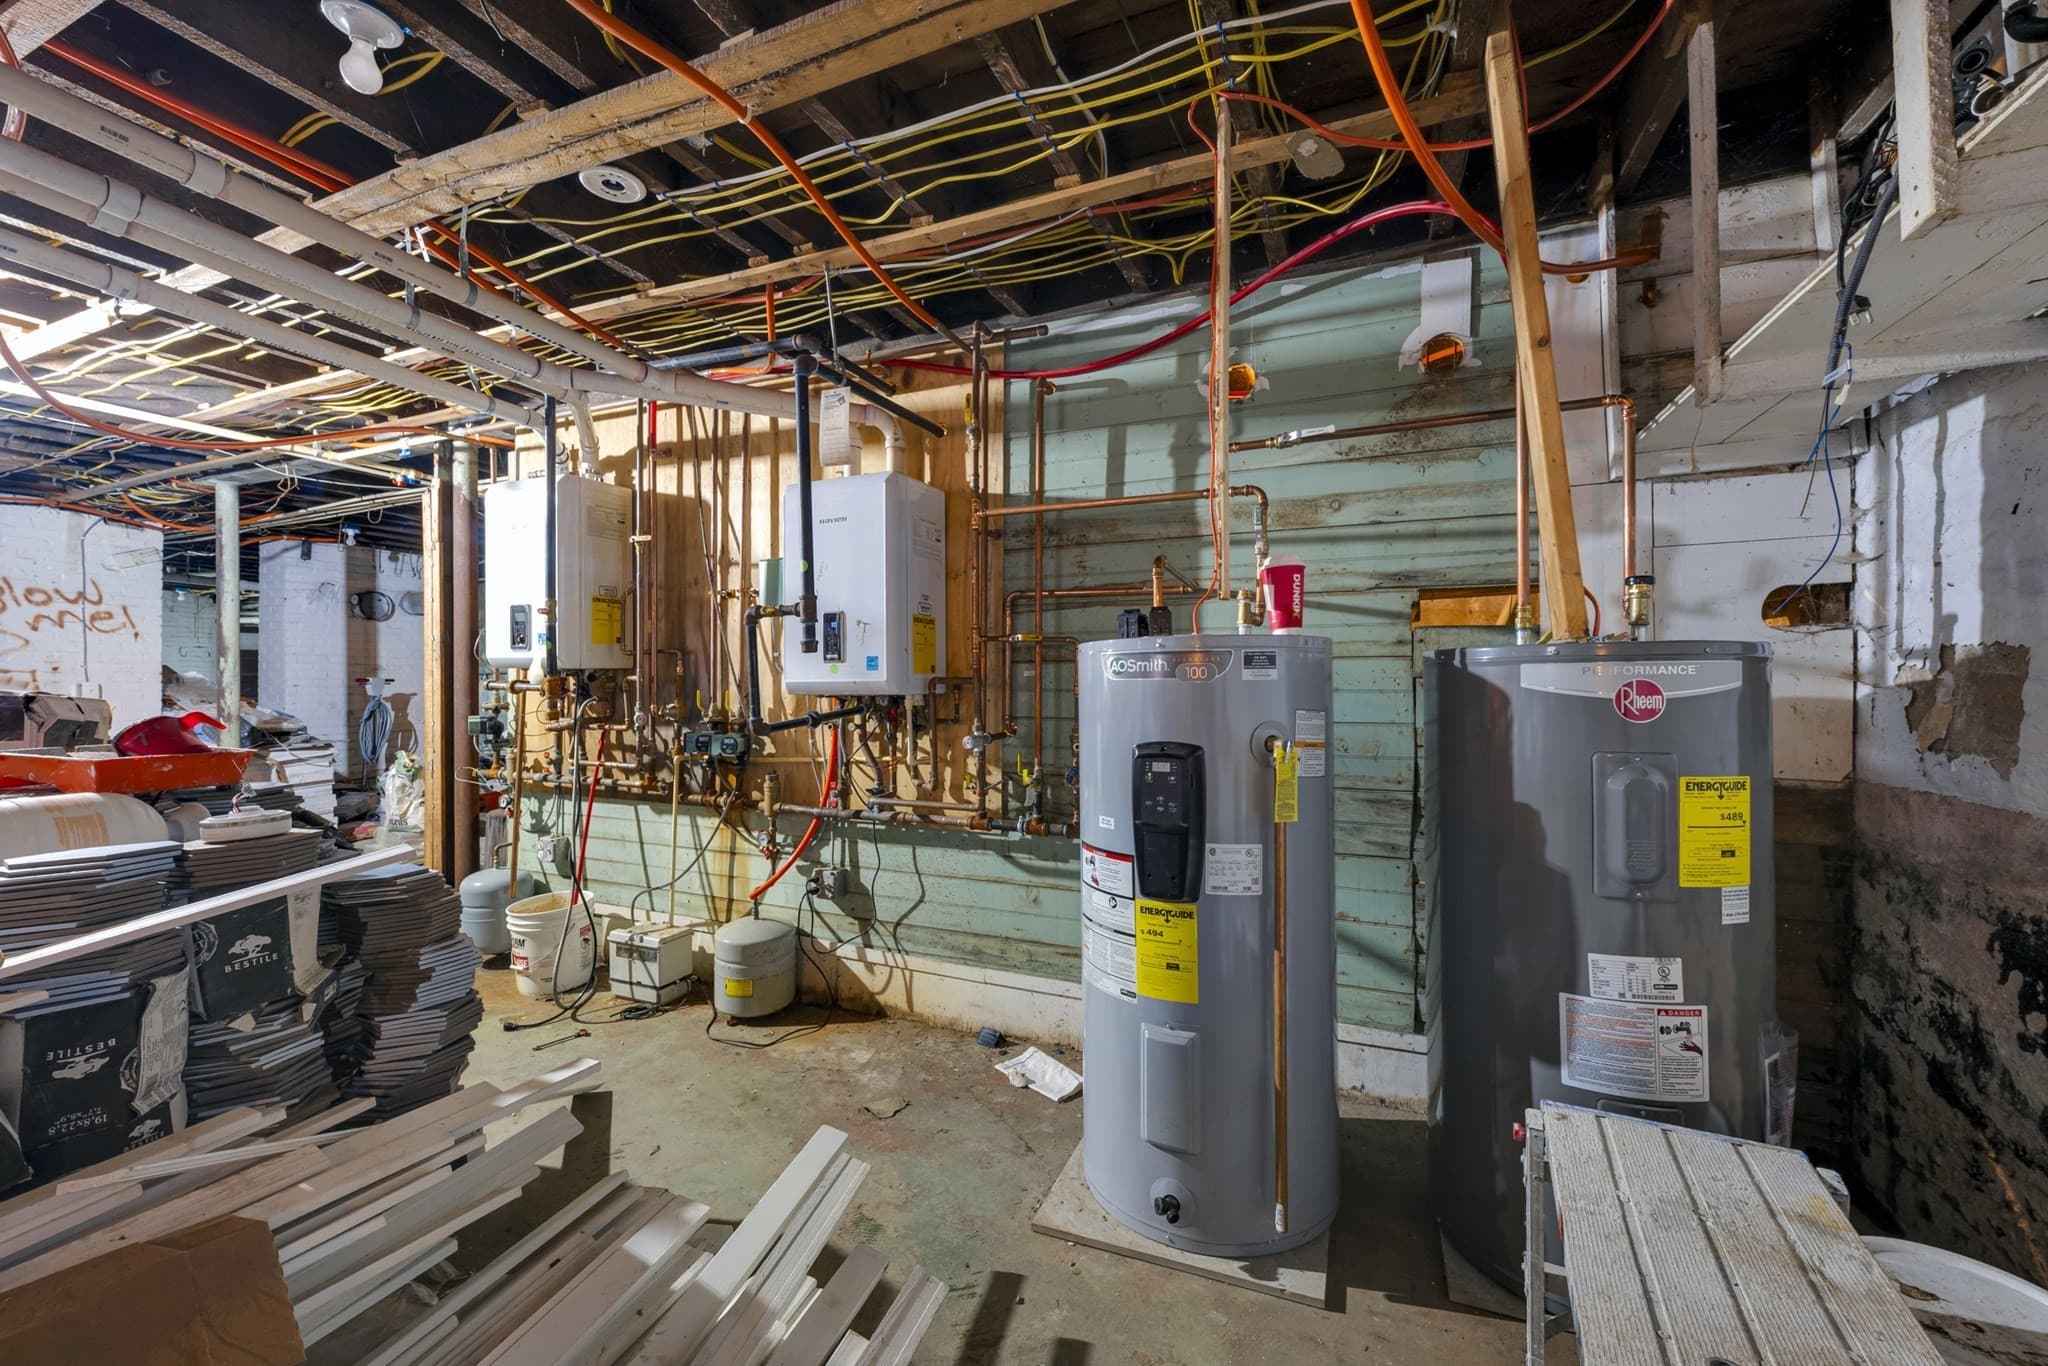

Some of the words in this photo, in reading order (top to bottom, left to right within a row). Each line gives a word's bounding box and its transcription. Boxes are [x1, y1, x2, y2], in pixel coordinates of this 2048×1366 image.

[0, 575, 104, 615] low
[1185, 667, 1208, 679] 100
[1620, 679, 1663, 716] Rheem
[224, 952, 279, 973] BESTILE
[1668, 1009, 1701, 1017] DANGER
[46, 1038, 116, 1061] BESTILE
